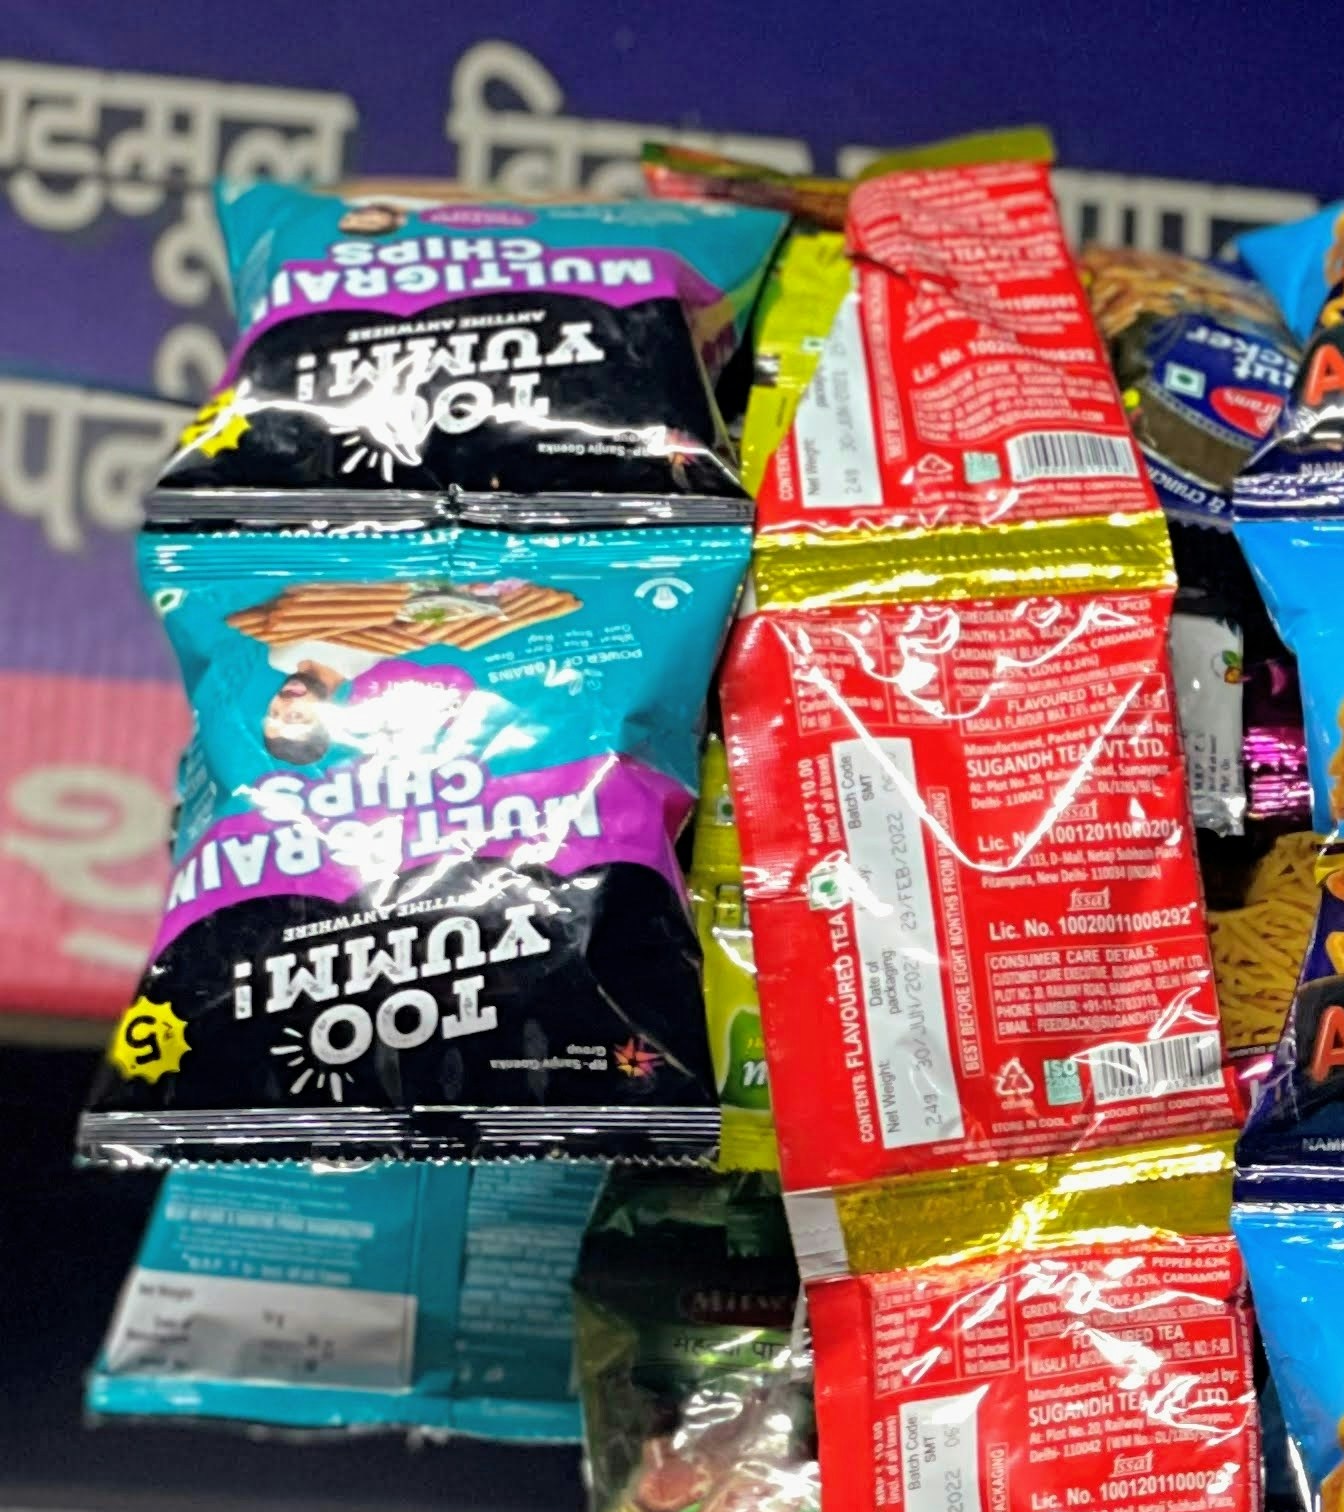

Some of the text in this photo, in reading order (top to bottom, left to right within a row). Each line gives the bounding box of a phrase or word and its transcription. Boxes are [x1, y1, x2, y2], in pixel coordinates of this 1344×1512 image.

[331, 238, 544, 267] CHIPS
[1007, 682, 1117, 713] FLAVOURED TEA
[966, 754, 1054, 779] SUGANDH
[258, 759, 485, 822] CHIPS
[860, 773, 875, 802] SMT
[845, 792, 862, 830] Batch
[977, 834, 1009, 853] Lic.
[989, 919, 1054, 941] Lic. No.
[234, 903, 551, 1019] YUMM!
[937, 859, 981, 1072] BEST BEFORE EIGHT MONTHS FROM
[990, 949, 1099, 970] CONSUMER CARE
[829, 910, 865, 1069] FLAVOURED TEA
[868, 976, 884, 1007] Date
[309, 976, 498, 1066] TOO
[887, 1110, 901, 1133] Net
[1158, 1325, 1185, 1341] TEA
[1028, 1398, 1114, 1427] SUGANDH
[923, 1436, 937, 1463] SMT
[907, 1453, 921, 1491] Batch
[1031, 1487, 1095, 1510] Lic. No.
